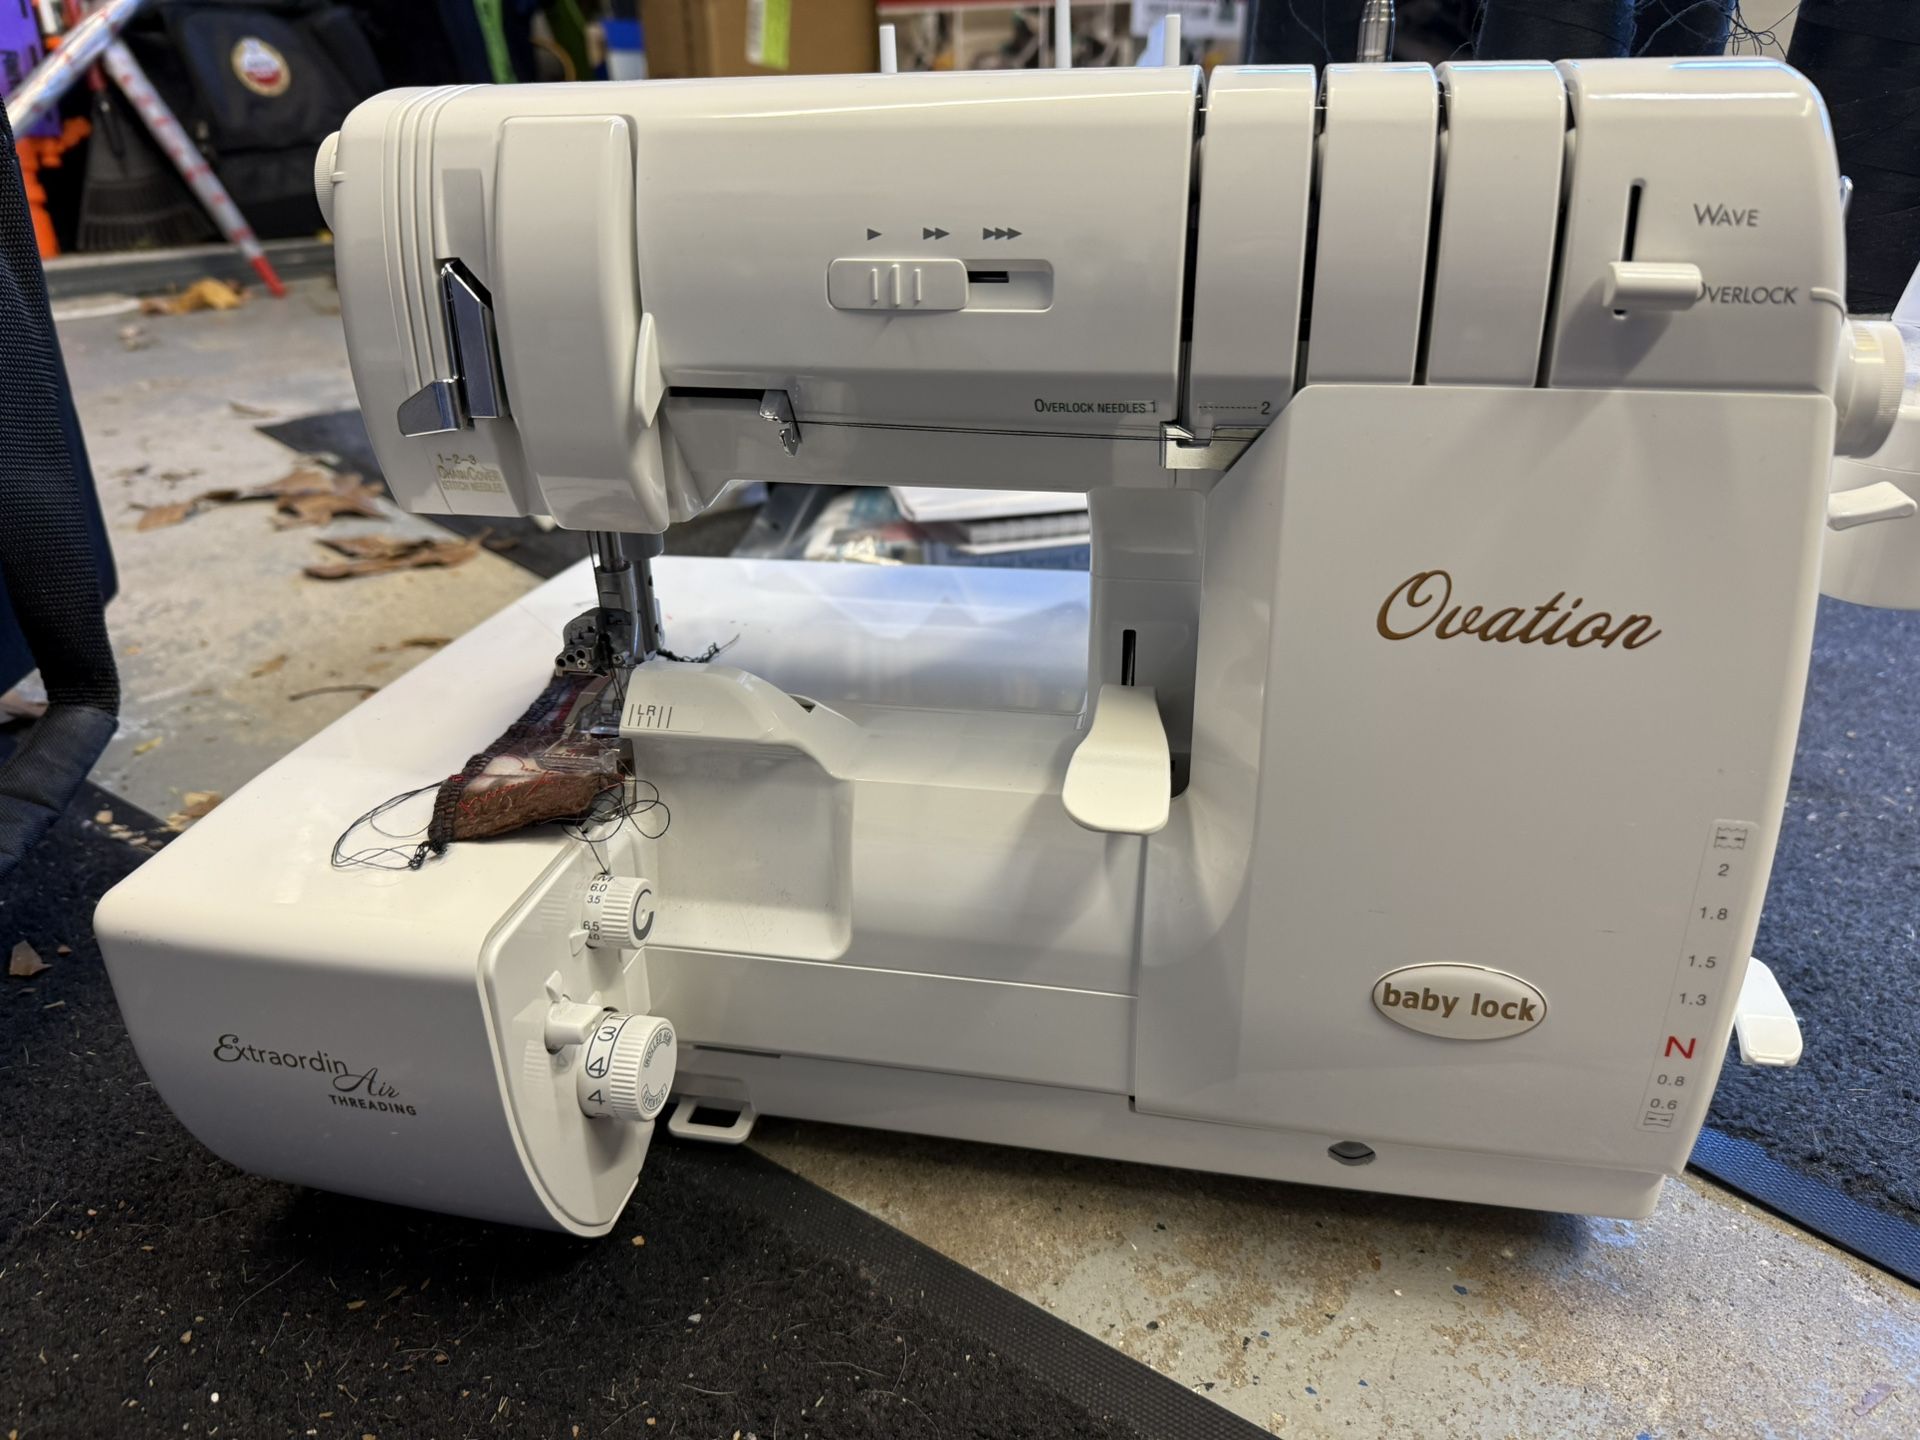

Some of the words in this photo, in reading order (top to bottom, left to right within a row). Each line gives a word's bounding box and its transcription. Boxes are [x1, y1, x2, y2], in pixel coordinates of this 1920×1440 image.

[1260, 401, 1271, 415] 2
[1376, 569, 1662, 649] Ovation
[1717, 863, 1730, 877] 2
[1699, 907, 1728, 921] 1.8
[1688, 954, 1717, 969] 1.5
[1381, 982, 1460, 1019] baby
[1470, 992, 1537, 1022] lock
[1679, 993, 1707, 1007] 1.3
[597, 1025, 618, 1042] 3
[1663, 1035, 1696, 1060] N
[588, 1056, 606, 1076] 4
[1656, 1073, 1685, 1087] 0.8
[587, 1088, 606, 1105] 4
[1650, 1097, 1678, 1111] 0.6
[328, 1094, 417, 1116] THREADING
